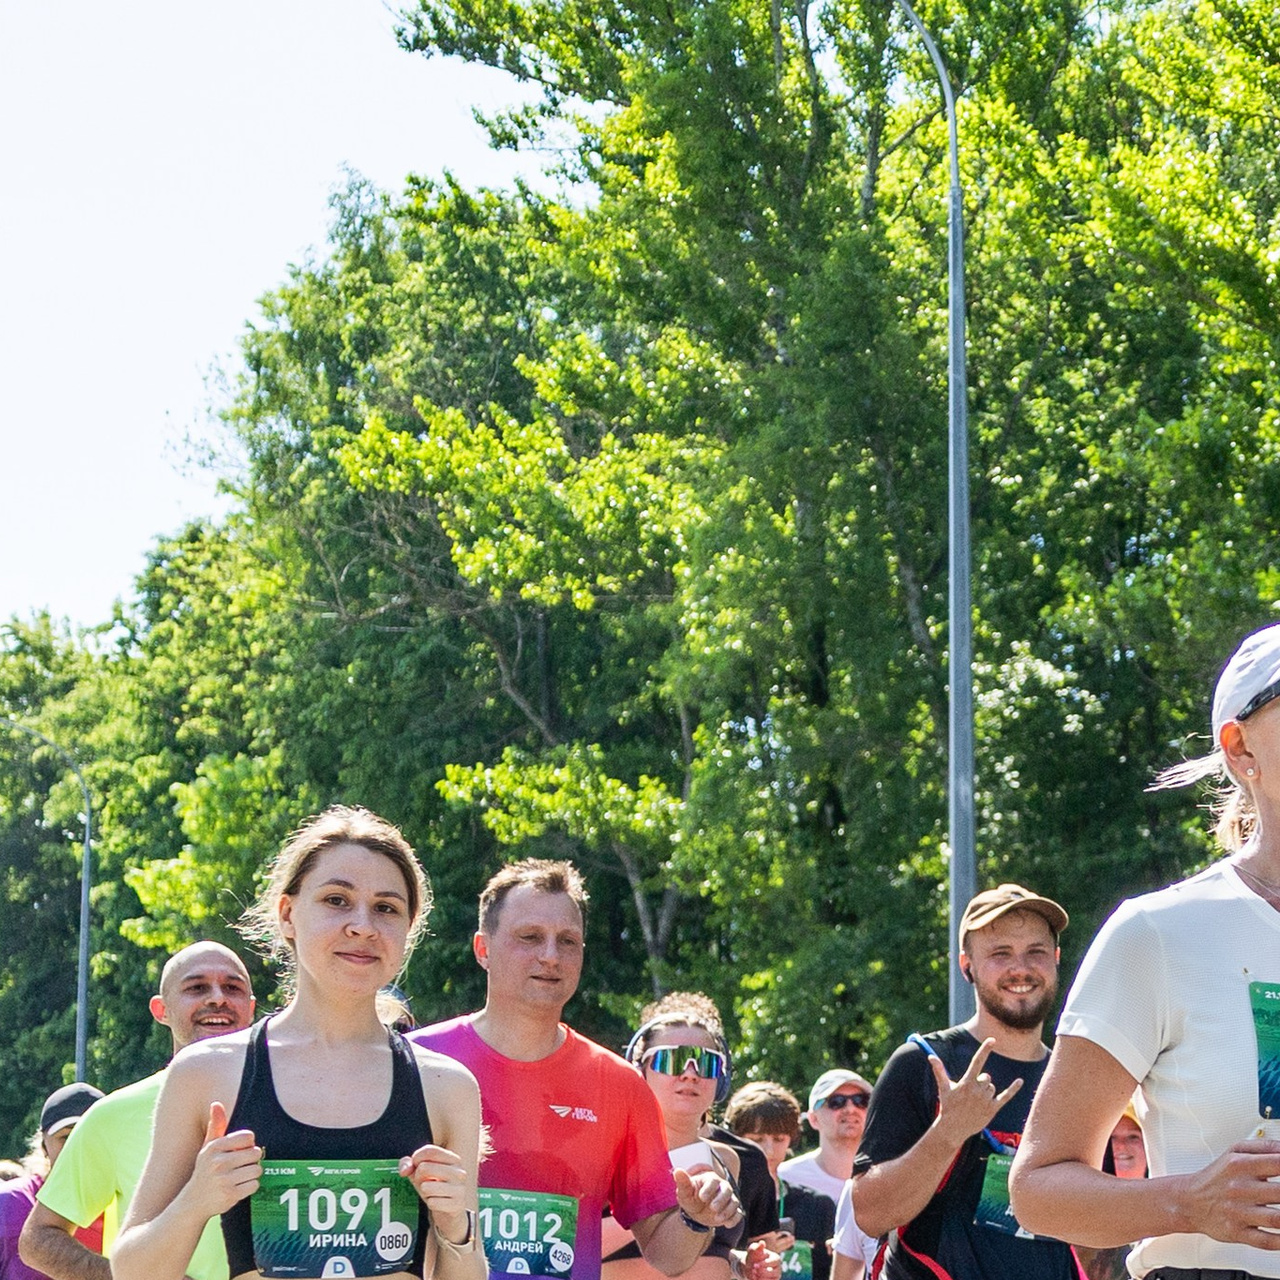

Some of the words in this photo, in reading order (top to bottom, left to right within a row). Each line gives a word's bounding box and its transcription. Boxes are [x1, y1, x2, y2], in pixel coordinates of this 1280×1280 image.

[280, 1187, 391, 1231] 1091
[479, 1207, 562, 1244] 1012
[309, 1234, 368, 1248] ИРИНА
[380, 1233, 408, 1251] 0860
[494, 1240, 544, 1254] АНДРЕЙ
[551, 1249, 573, 1266] 4268
[333, 1262, 346, 1274] D
[514, 1261, 524, 1271] D
